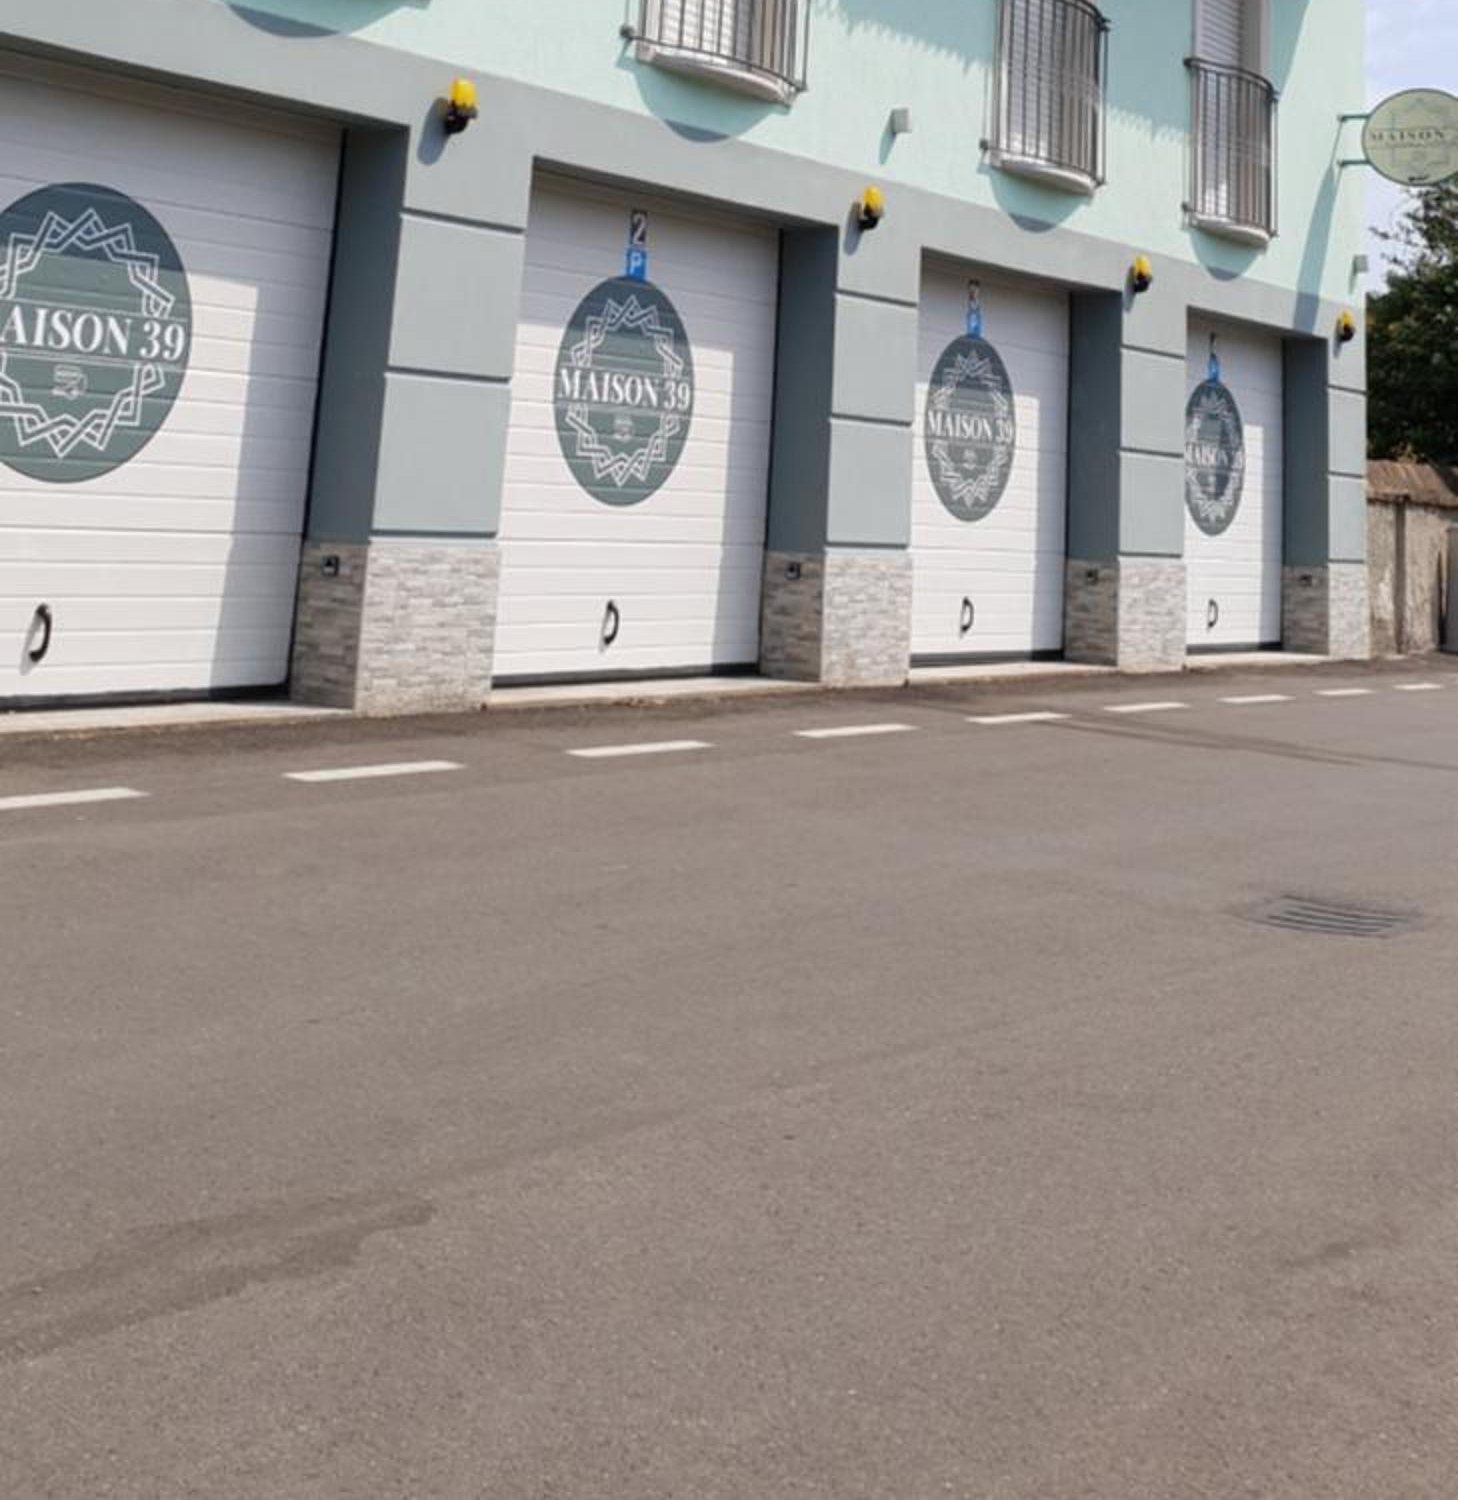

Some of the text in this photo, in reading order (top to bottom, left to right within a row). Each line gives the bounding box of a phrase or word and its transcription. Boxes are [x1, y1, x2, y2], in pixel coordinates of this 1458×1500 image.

[632, 213, 647, 245] 2
[629, 252, 642, 273] P
[0, 304, 185, 362] AISON 39
[557, 368, 691, 409] MAISON 39
[928, 409, 1014, 445] MAISON 39
